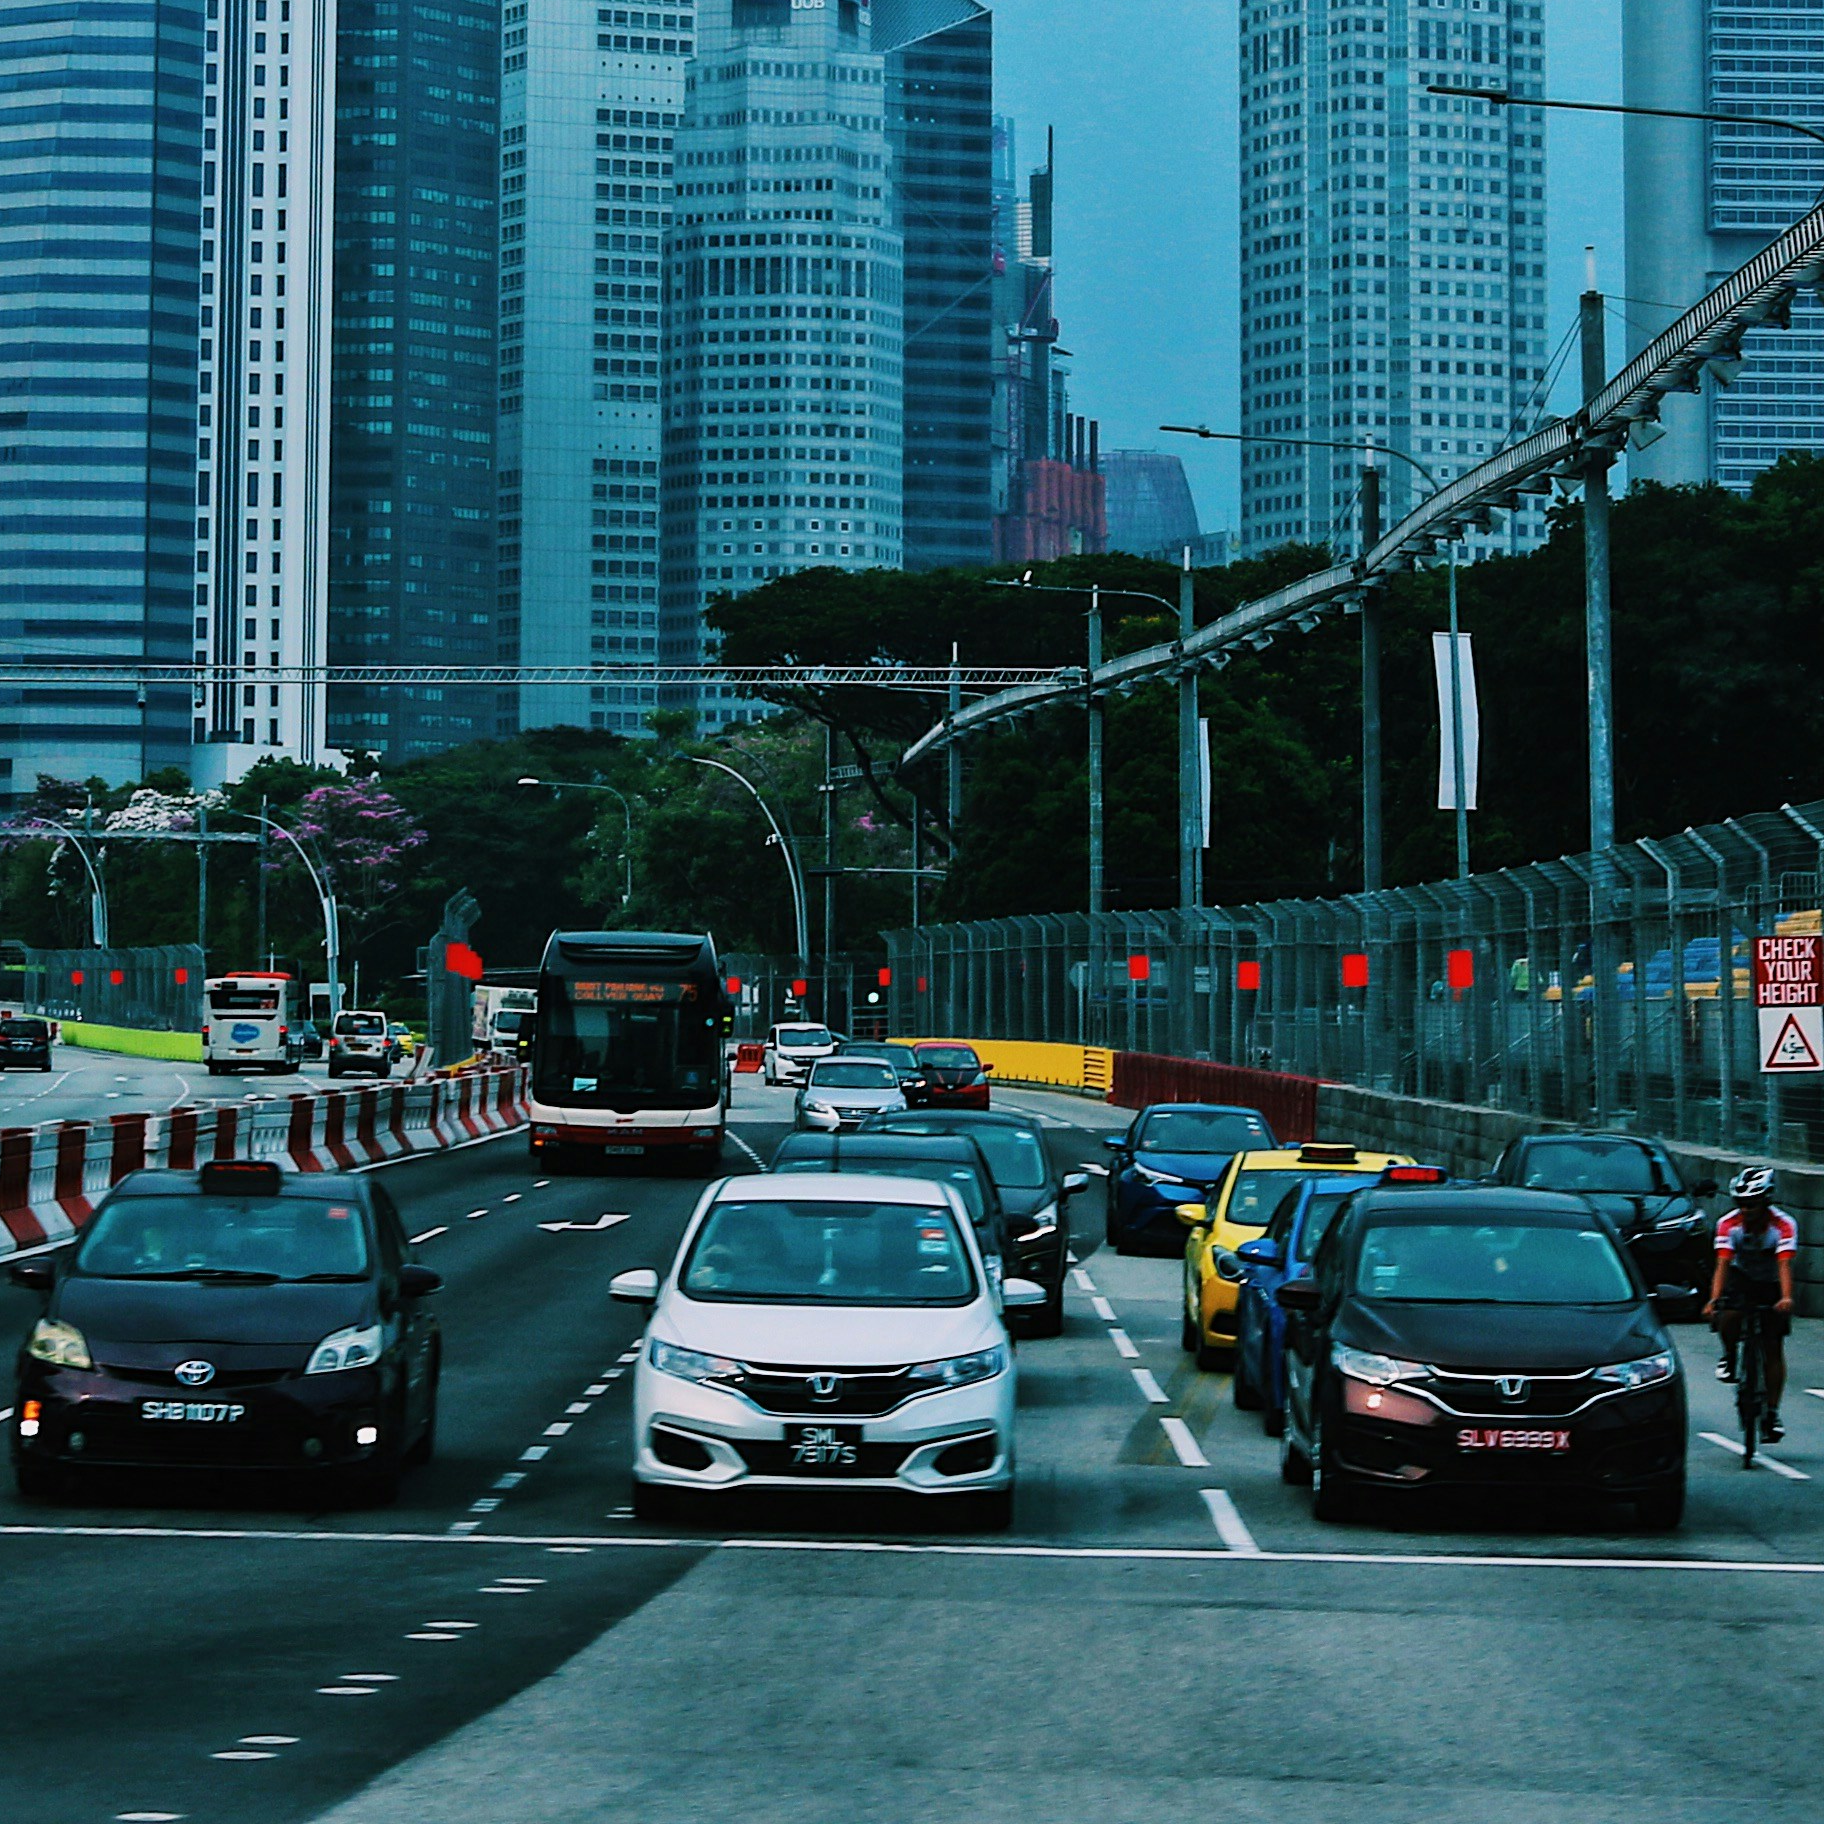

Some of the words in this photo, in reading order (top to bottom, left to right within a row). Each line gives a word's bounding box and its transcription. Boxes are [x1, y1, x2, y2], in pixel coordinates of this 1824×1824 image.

[1758, 938, 1816, 960] CHECK
[1764, 960, 1812, 982] YOUR
[678, 983, 698, 1002] 75
[1758, 982, 1819, 1005] HEIGHT
[141, 1401, 245, 1422] SHB1107P
[800, 1427, 845, 1445] SML
